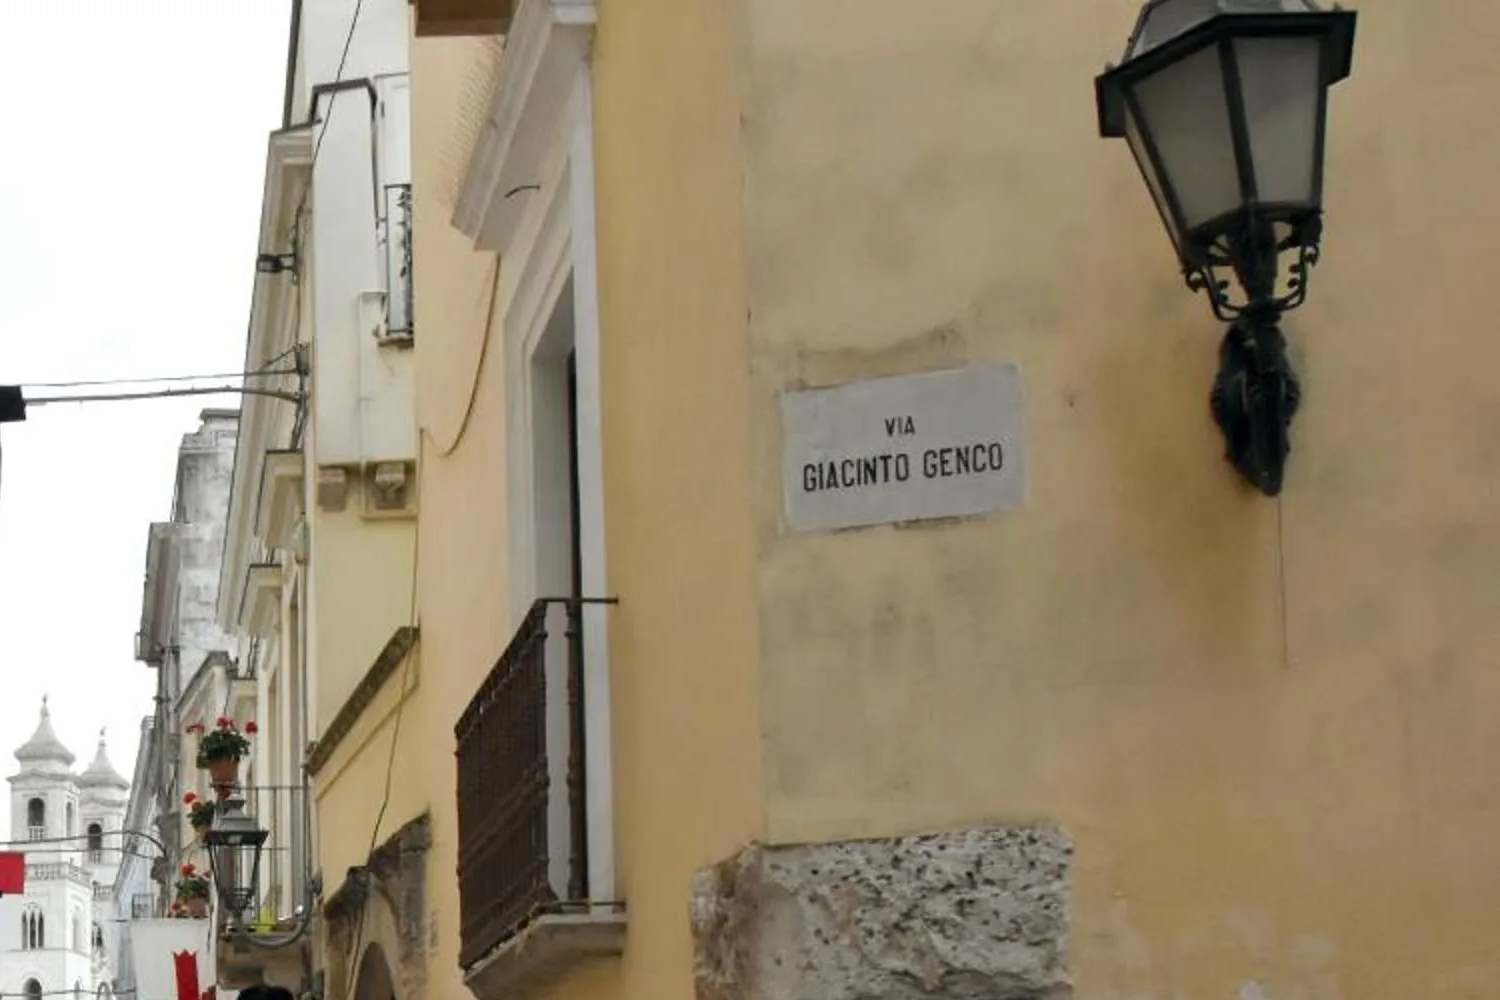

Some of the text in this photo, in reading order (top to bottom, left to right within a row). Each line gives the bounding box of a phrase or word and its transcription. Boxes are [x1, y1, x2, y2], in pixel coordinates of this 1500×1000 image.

[884, 415, 916, 437] VIA
[803, 442, 1003, 492] GIACINTO GENCO
